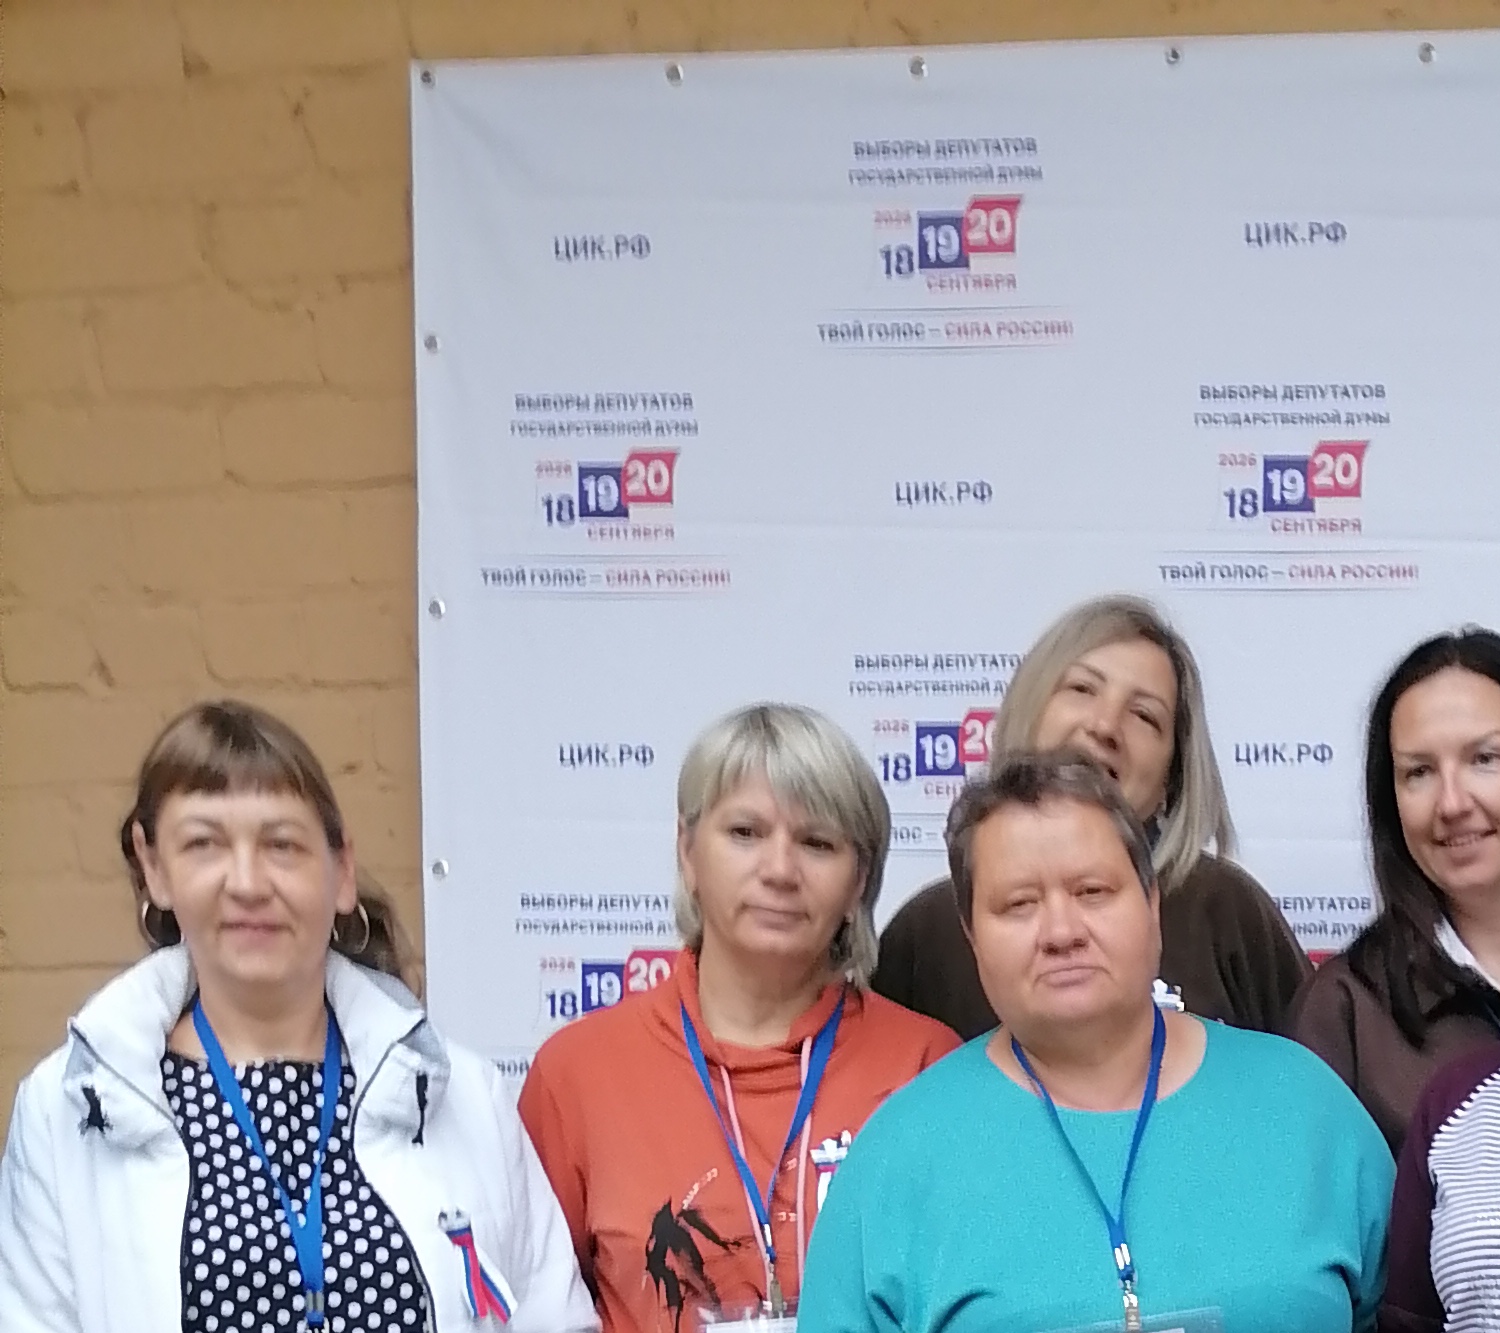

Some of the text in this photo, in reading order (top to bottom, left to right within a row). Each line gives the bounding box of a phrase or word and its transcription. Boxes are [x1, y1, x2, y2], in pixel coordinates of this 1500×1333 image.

[853, 137, 1037, 158] ВЫБОРЫ ДЕПУТАТОВ
[880, 208, 1013, 277] 18 19 20
[1245, 220, 1347, 249] ЦИК.РФ
[554, 234, 652, 263] ЦИК.РФ
[926, 273, 1017, 292] СЕНТЯБРЯ
[817, 321, 864, 341] ТВОЙ
[868, 322, 925, 341] ГОЛОС
[944, 322, 991, 340] СИЛА
[514, 392, 693, 413] ВЫБОРЫ ДЕПУТАТОВ
[1200, 384, 1386, 401] ВЫБОРЫ ДЕПУТАТОВ
[1194, 409, 1390, 427] ГОСУДАРСТВЕННОЙ ДУМЫ
[1218, 453, 1257, 466] 2026
[582, 475, 619, 512] 19
[626, 459, 669, 496] 20
[895, 480, 992, 508] ЦИК.РФ
[1224, 452, 1358, 518] 18 19 20
[1271, 518, 1362, 534] СЕНТЯБРЯ
[1159, 561, 1206, 581] ТВОЙ
[1211, 565, 1268, 581] ГОЛОС
[1289, 564, 1336, 580] СИЛА
[854, 654, 1024, 669] ВЫБОРЫ ДЕПУТАТО
[850, 677, 990, 695] ГОСУДАРСТВЕННОЙ
[558, 743, 655, 771] ЦИК.РФ
[879, 753, 911, 781] 18
[920, 734, 956, 770] 19
[1234, 741, 1333, 766] ЦИК.РФ
[521, 893, 670, 911] ВЫБОРЫ ДЕПУТАТ
[546, 957, 671, 1019] 18 19 20
